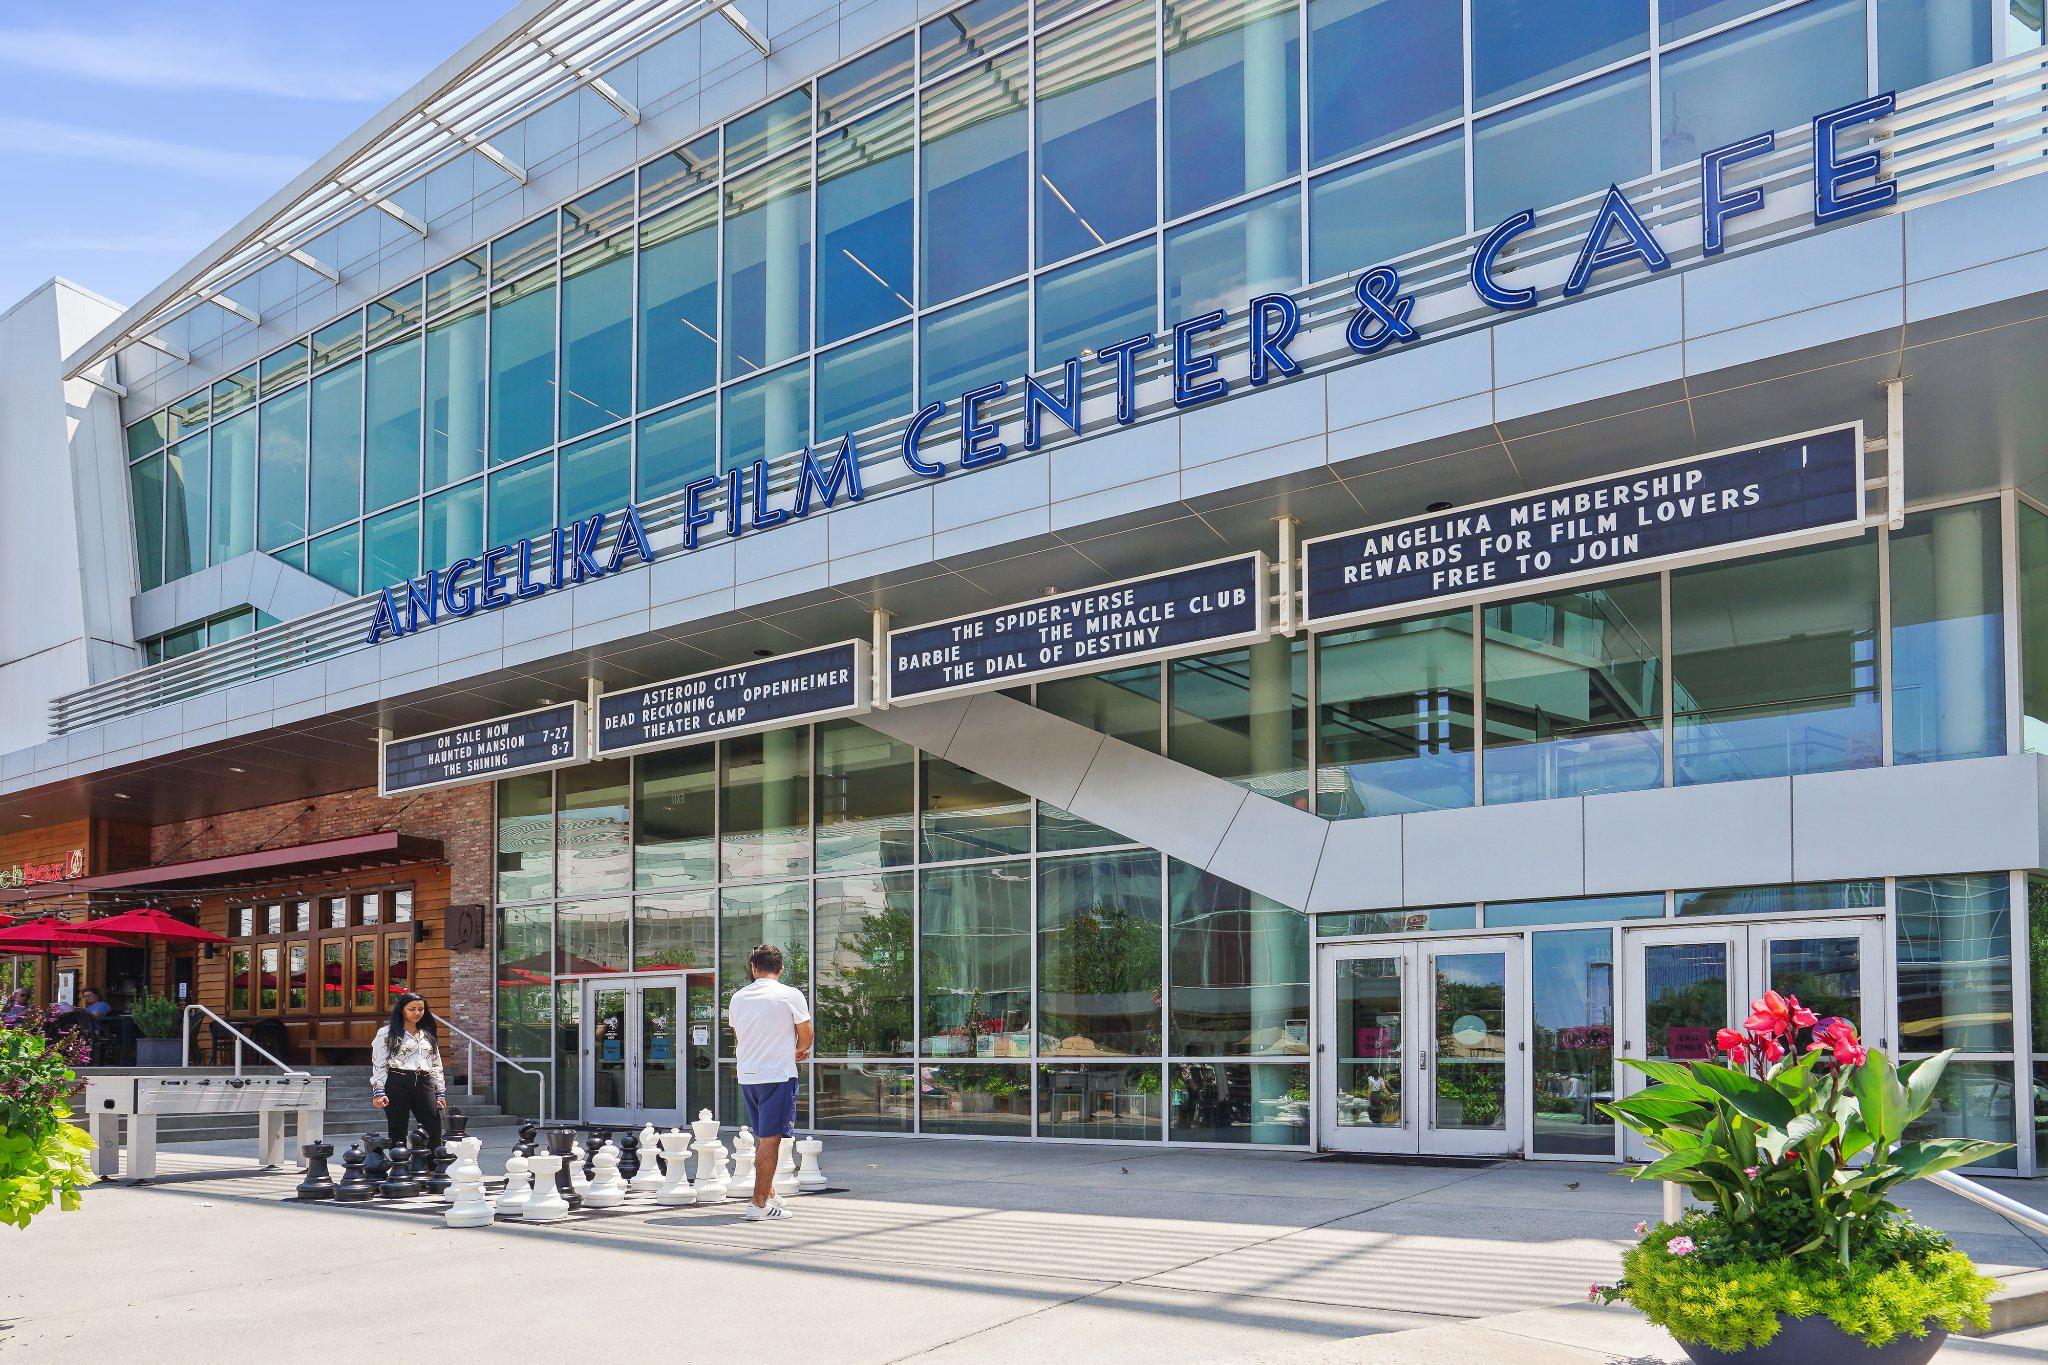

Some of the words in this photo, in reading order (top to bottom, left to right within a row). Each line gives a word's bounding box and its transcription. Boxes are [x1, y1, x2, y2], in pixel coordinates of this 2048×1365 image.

[367, 502, 654, 644] ANGELIKA
[684, 432, 864, 549] FILM
[902, 292, 1303, 478] CENTER
[1346, 265, 1420, 354] &
[1471, 90, 1897, 310] CAFE
[1344, 546, 1462, 583] REWARDS
[1480, 531, 1531, 558] FOR
[1550, 513, 1618, 543] FILM
[1638, 483, 1760, 525] LOVERS
[1363, 512, 1490, 556] ANGELIKA
[1510, 469, 1703, 525] MEMBERSHIP
[1433, 562, 1496, 589] FREE
[1517, 552, 1550, 575] TO
[1570, 533, 1639, 562] JOIN
[898, 646, 960, 671] BARBIE
[1038, 623, 1073, 644] THE
[1086, 602, 1175, 634] MIRACLE
[1189, 588, 1246, 613] CLUB
[952, 622, 983, 642] THE
[995, 589, 1134, 633] SPIDER-VERSE
[943, 663, 975, 683] THE
[986, 653, 1026, 675] DIAL
[1039, 645, 1063, 663] OF
[1075, 626, 1160, 658] DESTINY
[605, 712, 635, 730] DEAD
[642, 695, 715, 723] RECKONING
[743, 668, 848, 702] OPPENHEIMER
[642, 680, 707, 706] ASTEROID
[714, 672, 747, 691] CITY
[428, 746, 472, 765] HAUNTED
[478, 735, 525, 754] MANSION
[543, 726, 568, 742] 7-27
[438, 736, 450, 749] ON
[456, 728, 481, 743] SALE
[487, 722, 509, 737] NOW
[643, 716, 700, 739] THEATER
[708, 707, 746, 726] CAMP
[443, 763, 461, 777] THE
[467, 753, 508, 772] SHINING
[551, 741, 570, 756] 8-7
